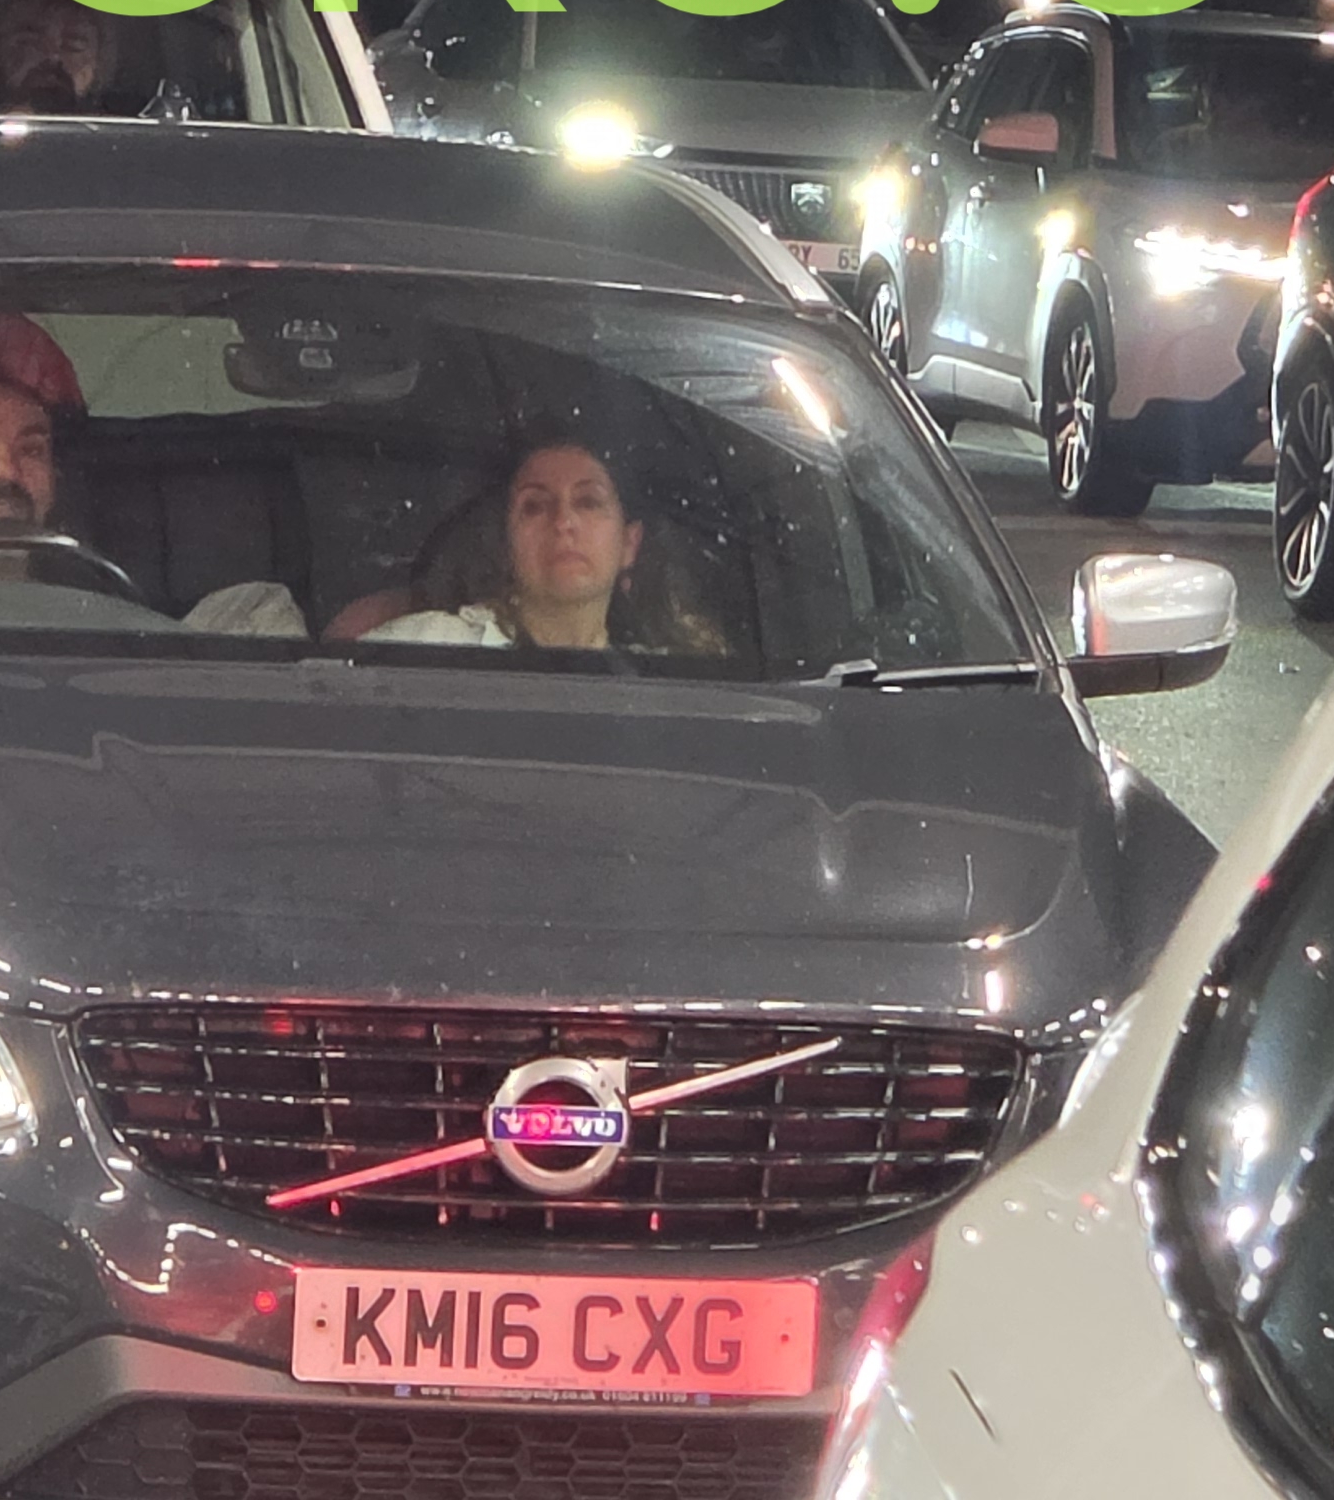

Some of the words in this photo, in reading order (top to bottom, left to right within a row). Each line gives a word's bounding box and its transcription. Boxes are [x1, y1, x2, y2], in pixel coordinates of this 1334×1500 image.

[499, 1110, 617, 1137] VOLVO
[342, 1286, 541, 1370] KM16
[572, 1295, 744, 1376] CXG
